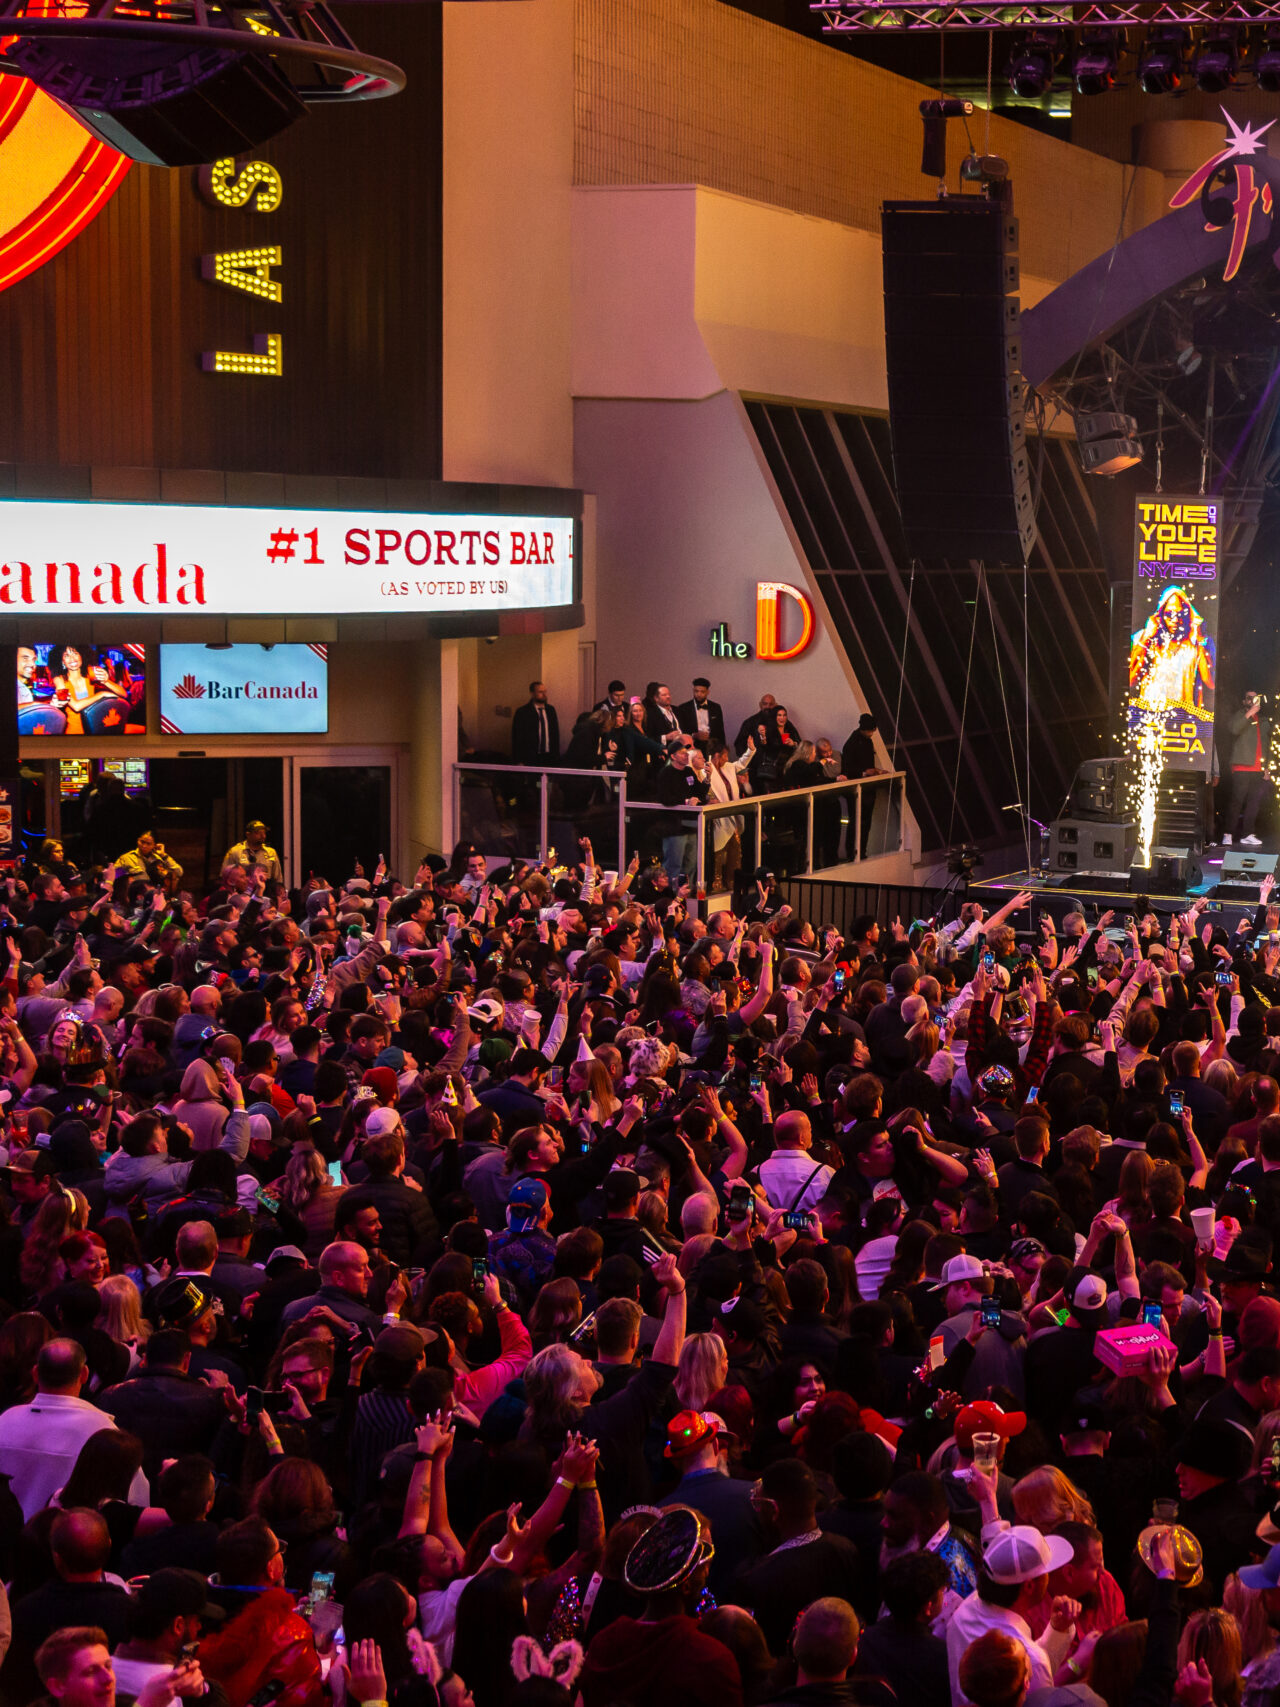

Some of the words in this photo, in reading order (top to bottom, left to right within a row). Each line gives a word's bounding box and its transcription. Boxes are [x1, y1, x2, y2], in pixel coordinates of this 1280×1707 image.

[212, 158, 284, 377] LAS
[1138, 503, 1209, 524] TIME
[1138, 522, 1217, 544] YOUR
[266, 526, 325, 565] #1
[344, 527, 501, 566] SPORTS
[509, 531, 556, 565] BAR
[1138, 541, 1217, 563] LIFE
[0, 543, 207, 605] anada
[1138, 561, 1217, 580] NYE25
[380, 580, 409, 596] (AS
[415, 580, 466, 596] VOTED
[469, 580, 486, 595] BY
[489, 579, 509, 595] US)
[710, 622, 748, 659] the
[755, 581, 817, 661] D
[207, 680, 319, 700] BarCanada
[1136, 735, 1206, 755] DA
